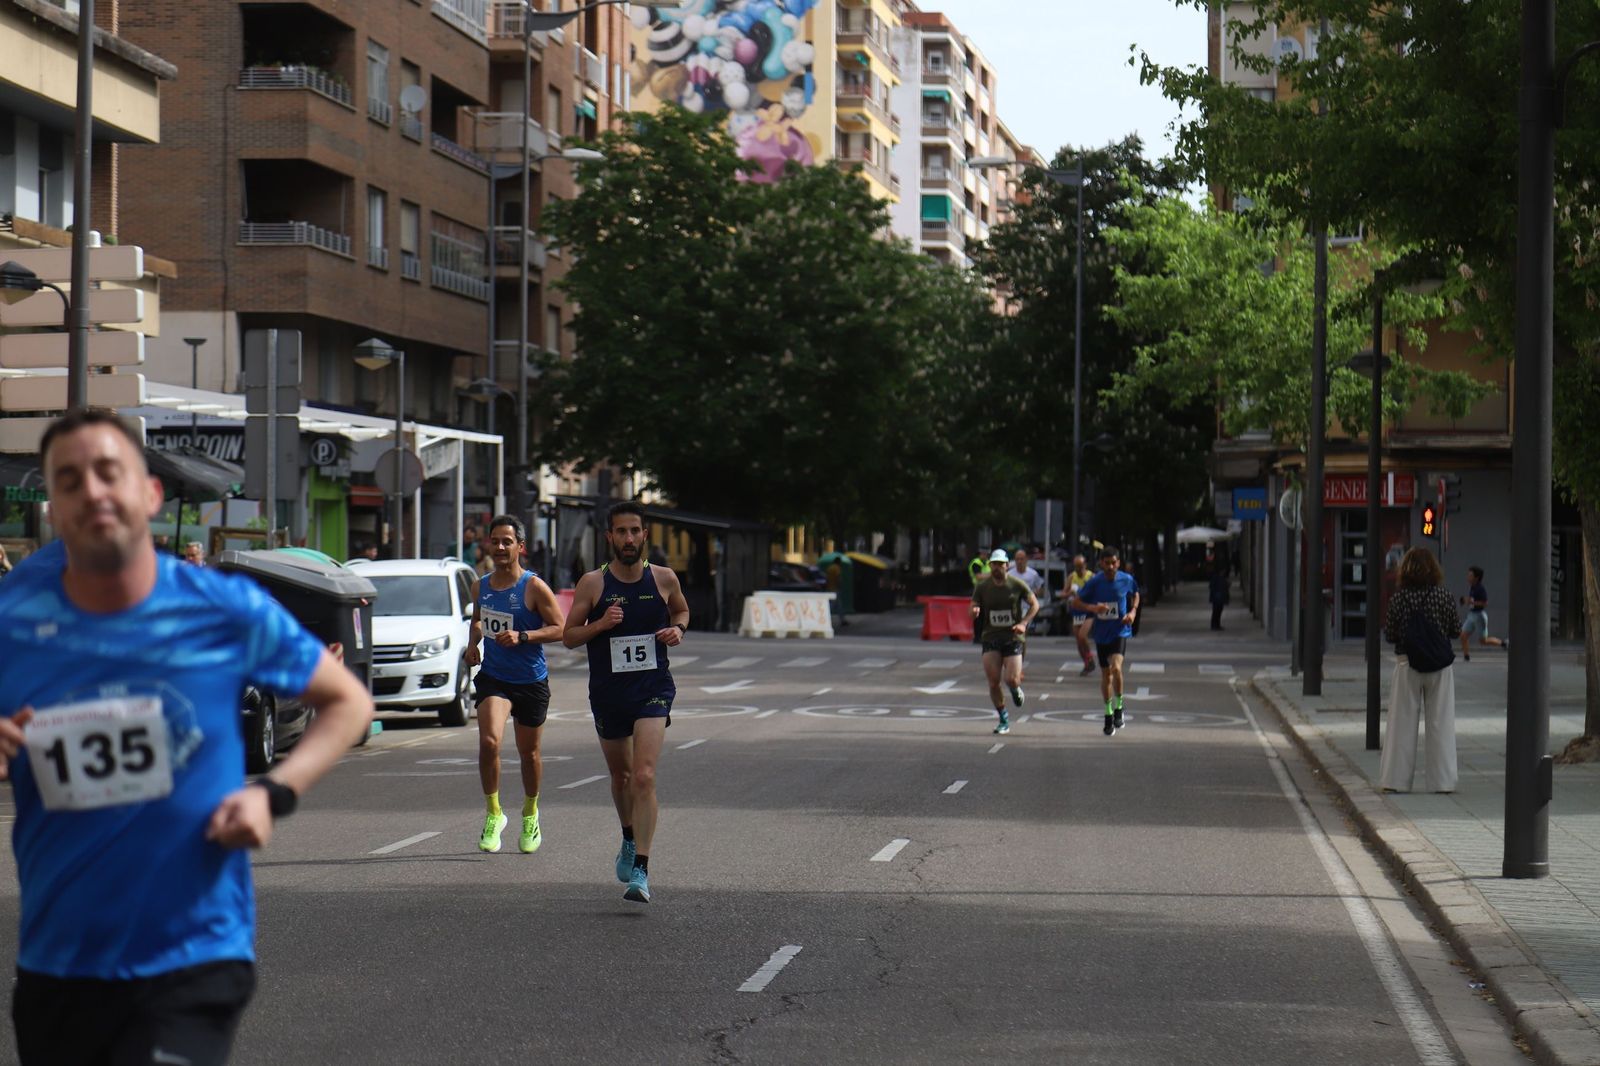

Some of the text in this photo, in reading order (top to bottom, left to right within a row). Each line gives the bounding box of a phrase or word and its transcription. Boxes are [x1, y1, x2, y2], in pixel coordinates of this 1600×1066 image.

[483, 617, 508, 633] 101
[992, 614, 1010, 623] 199
[622, 645, 647, 663] 15
[44, 726, 155, 784] 135
